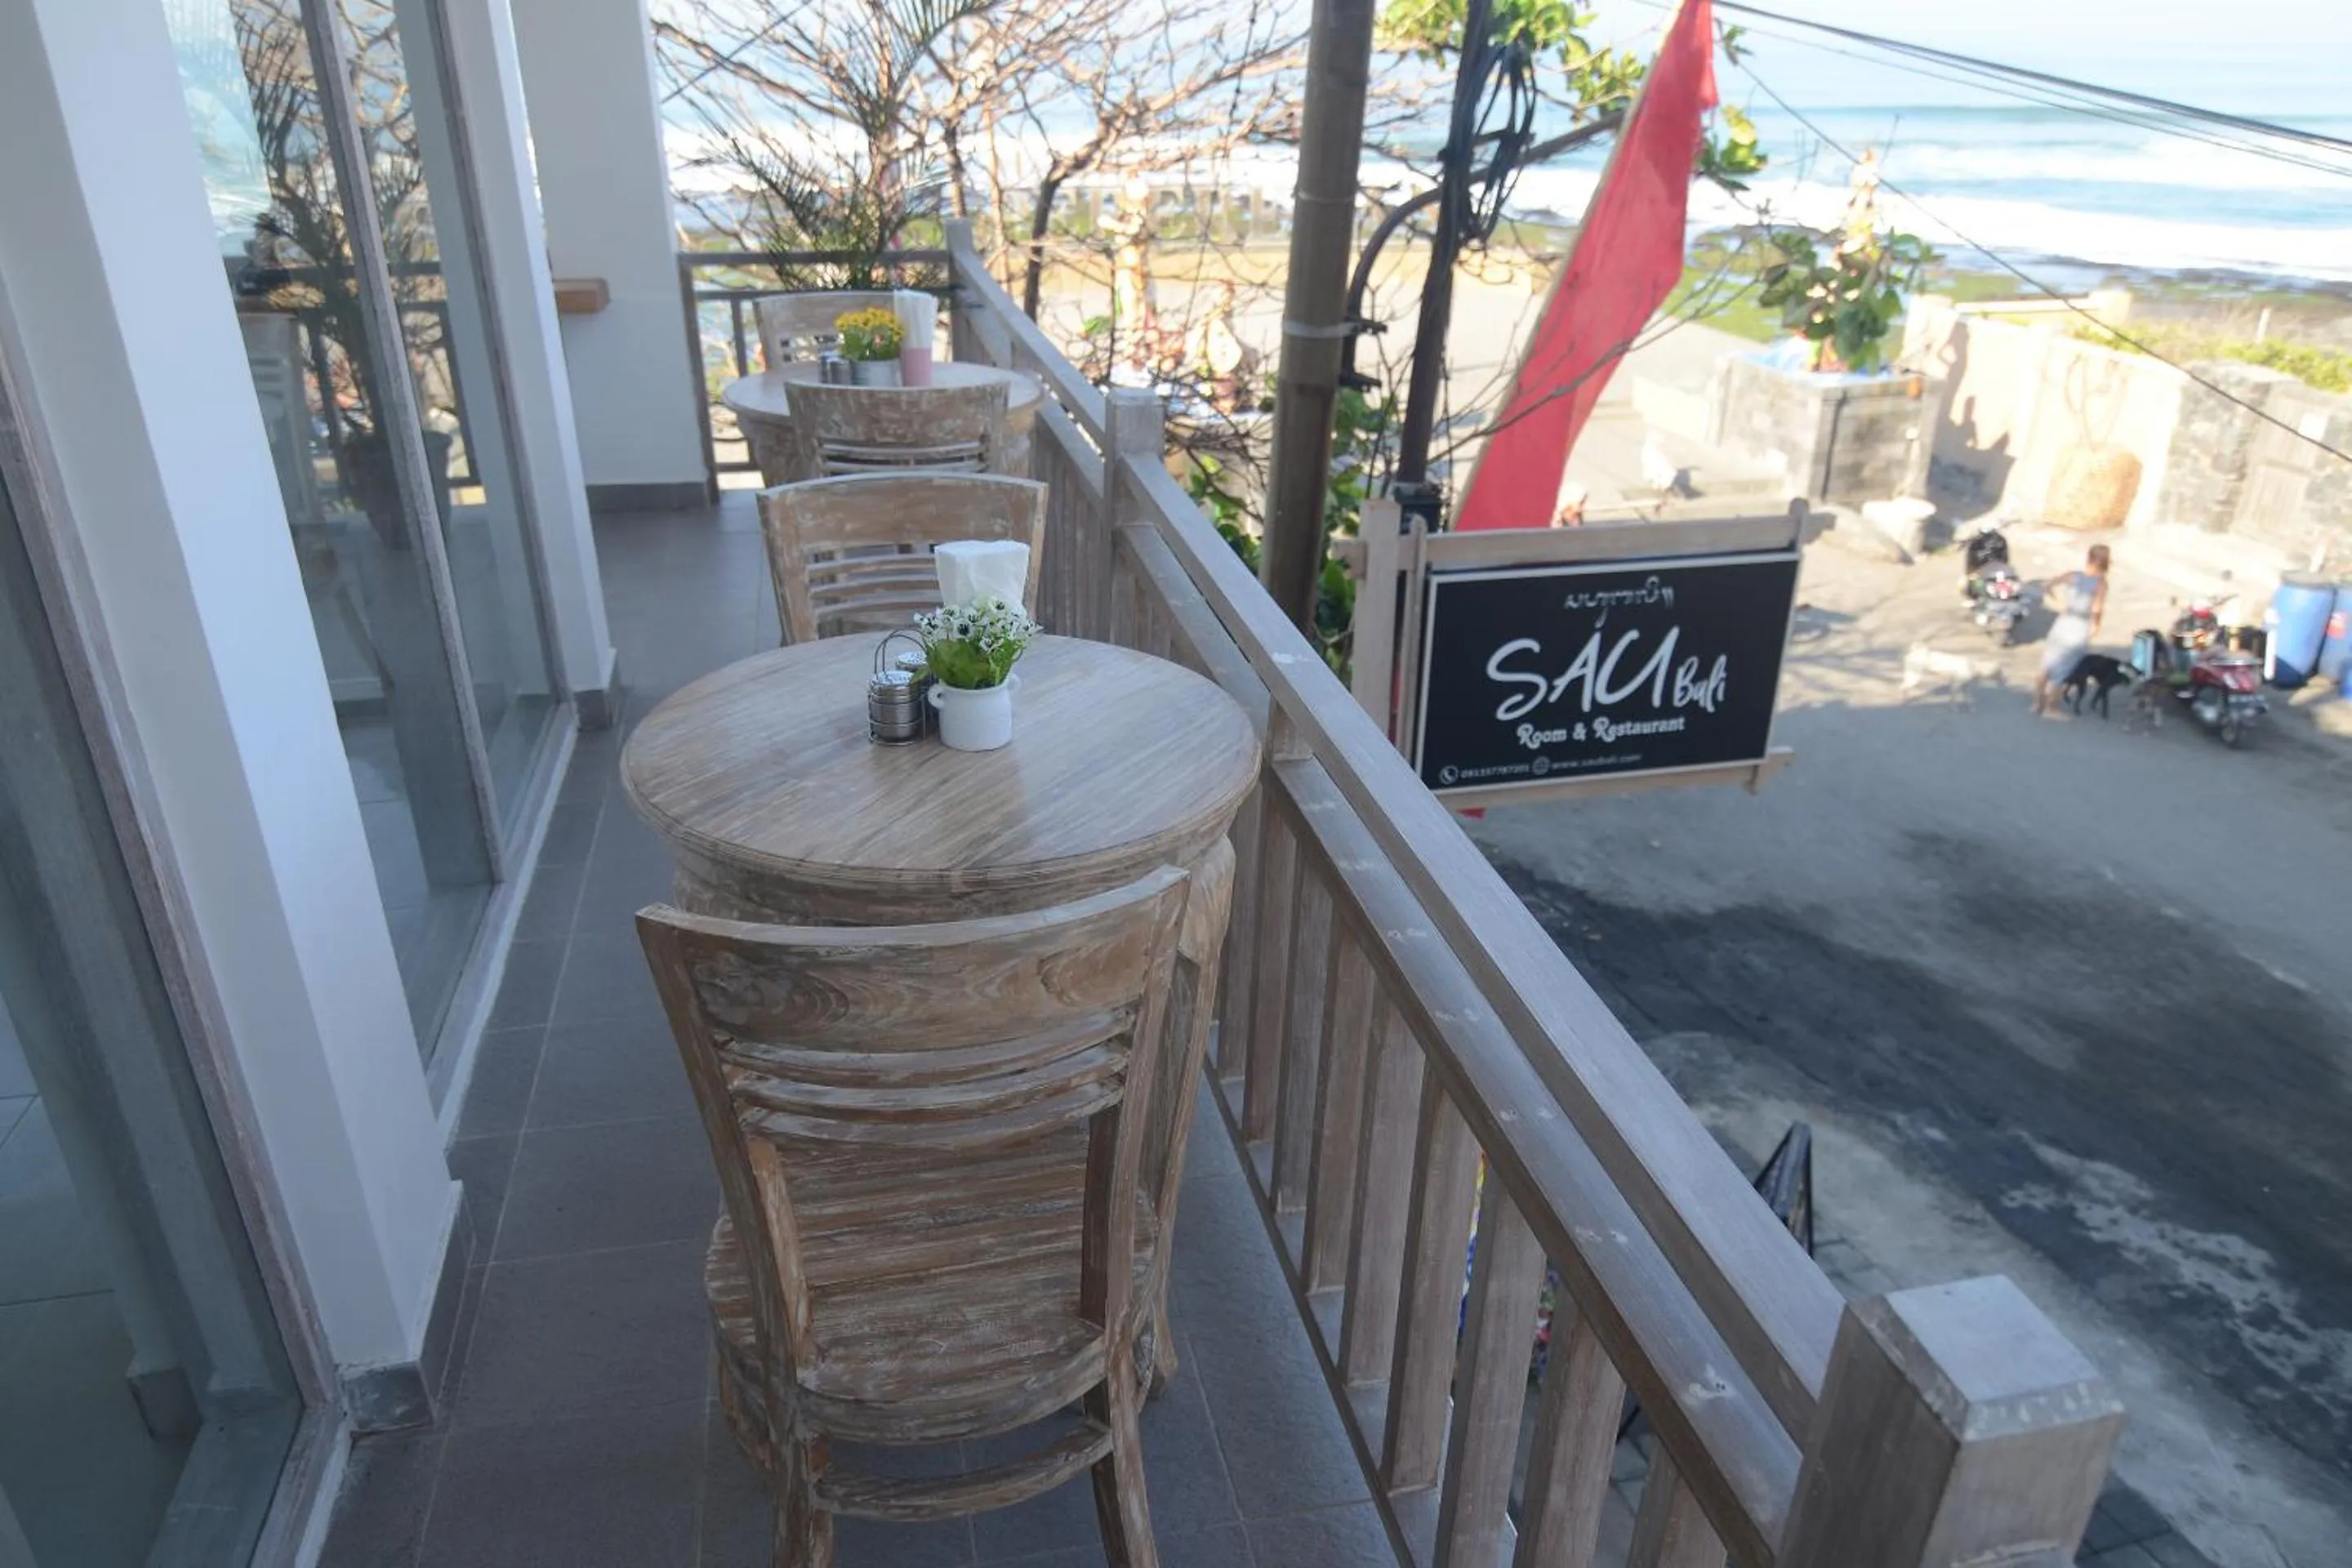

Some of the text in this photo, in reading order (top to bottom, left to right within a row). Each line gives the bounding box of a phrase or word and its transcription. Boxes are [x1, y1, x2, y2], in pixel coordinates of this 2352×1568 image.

[1673, 654, 1727, 712] Bali
[1517, 716, 1685, 749] Room & Restaurant
